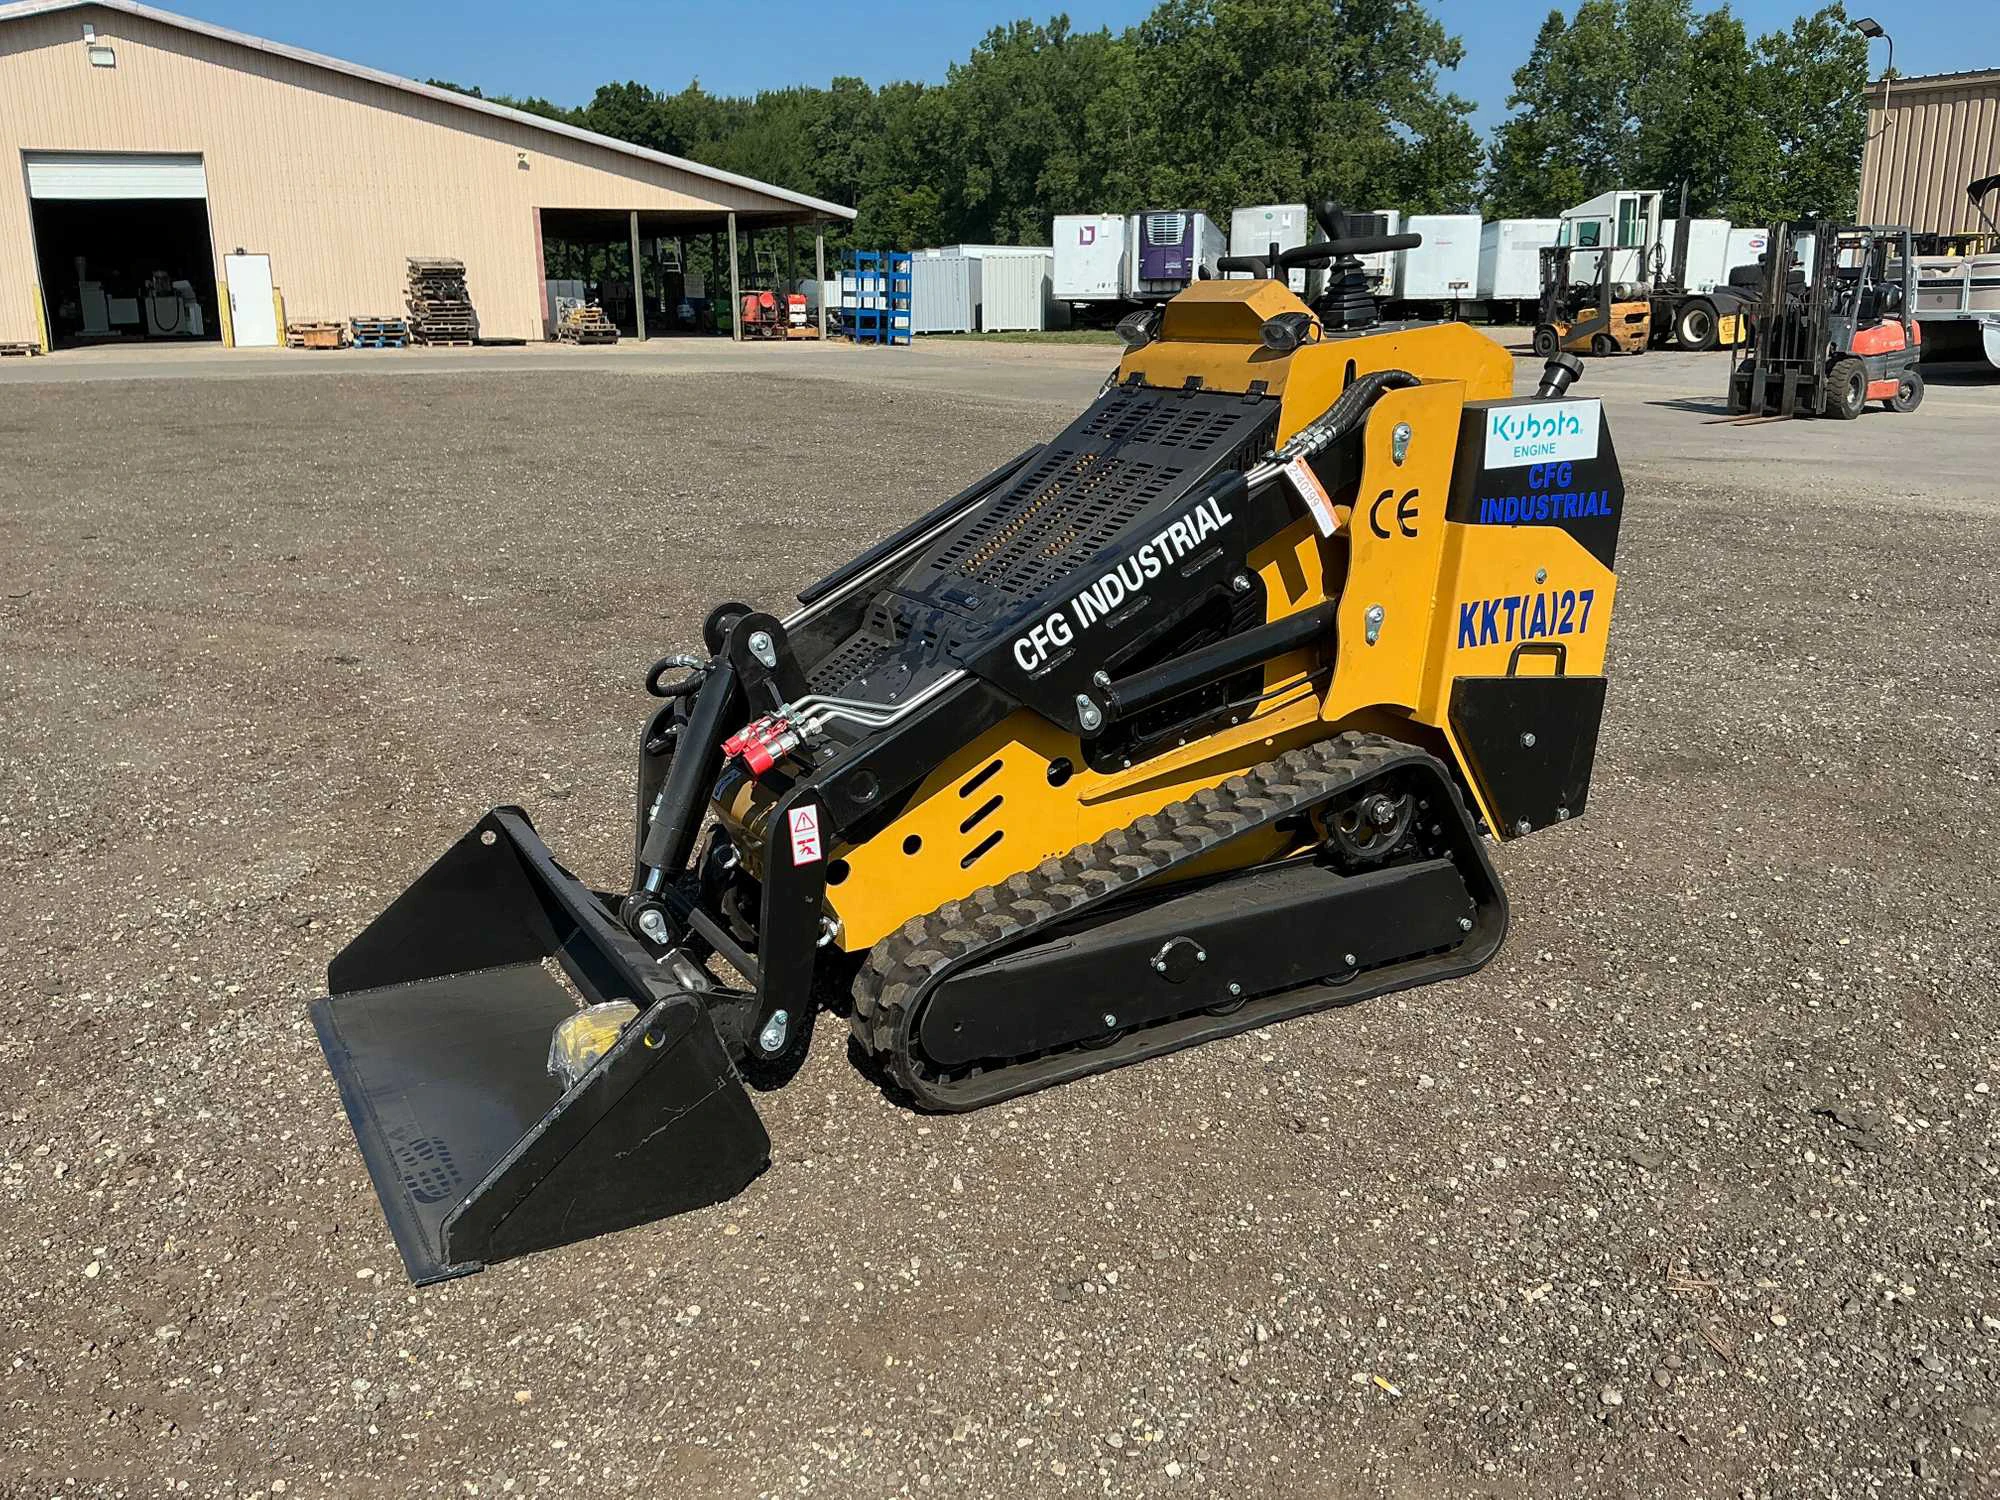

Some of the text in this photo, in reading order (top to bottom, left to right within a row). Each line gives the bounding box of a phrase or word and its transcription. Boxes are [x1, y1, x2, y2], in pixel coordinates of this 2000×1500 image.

[1493, 411, 1579, 441] Kubota
[1513, 442, 1556, 458] ENGINE
[1528, 461, 1573, 489] CFG
[1369, 488, 1419, 540] CE
[1479, 490, 1614, 524] INDUSTRIAL
[1013, 496, 1233, 671] CFG INDUSTRIAL
[1457, 589, 1595, 650] KKT(A)27
